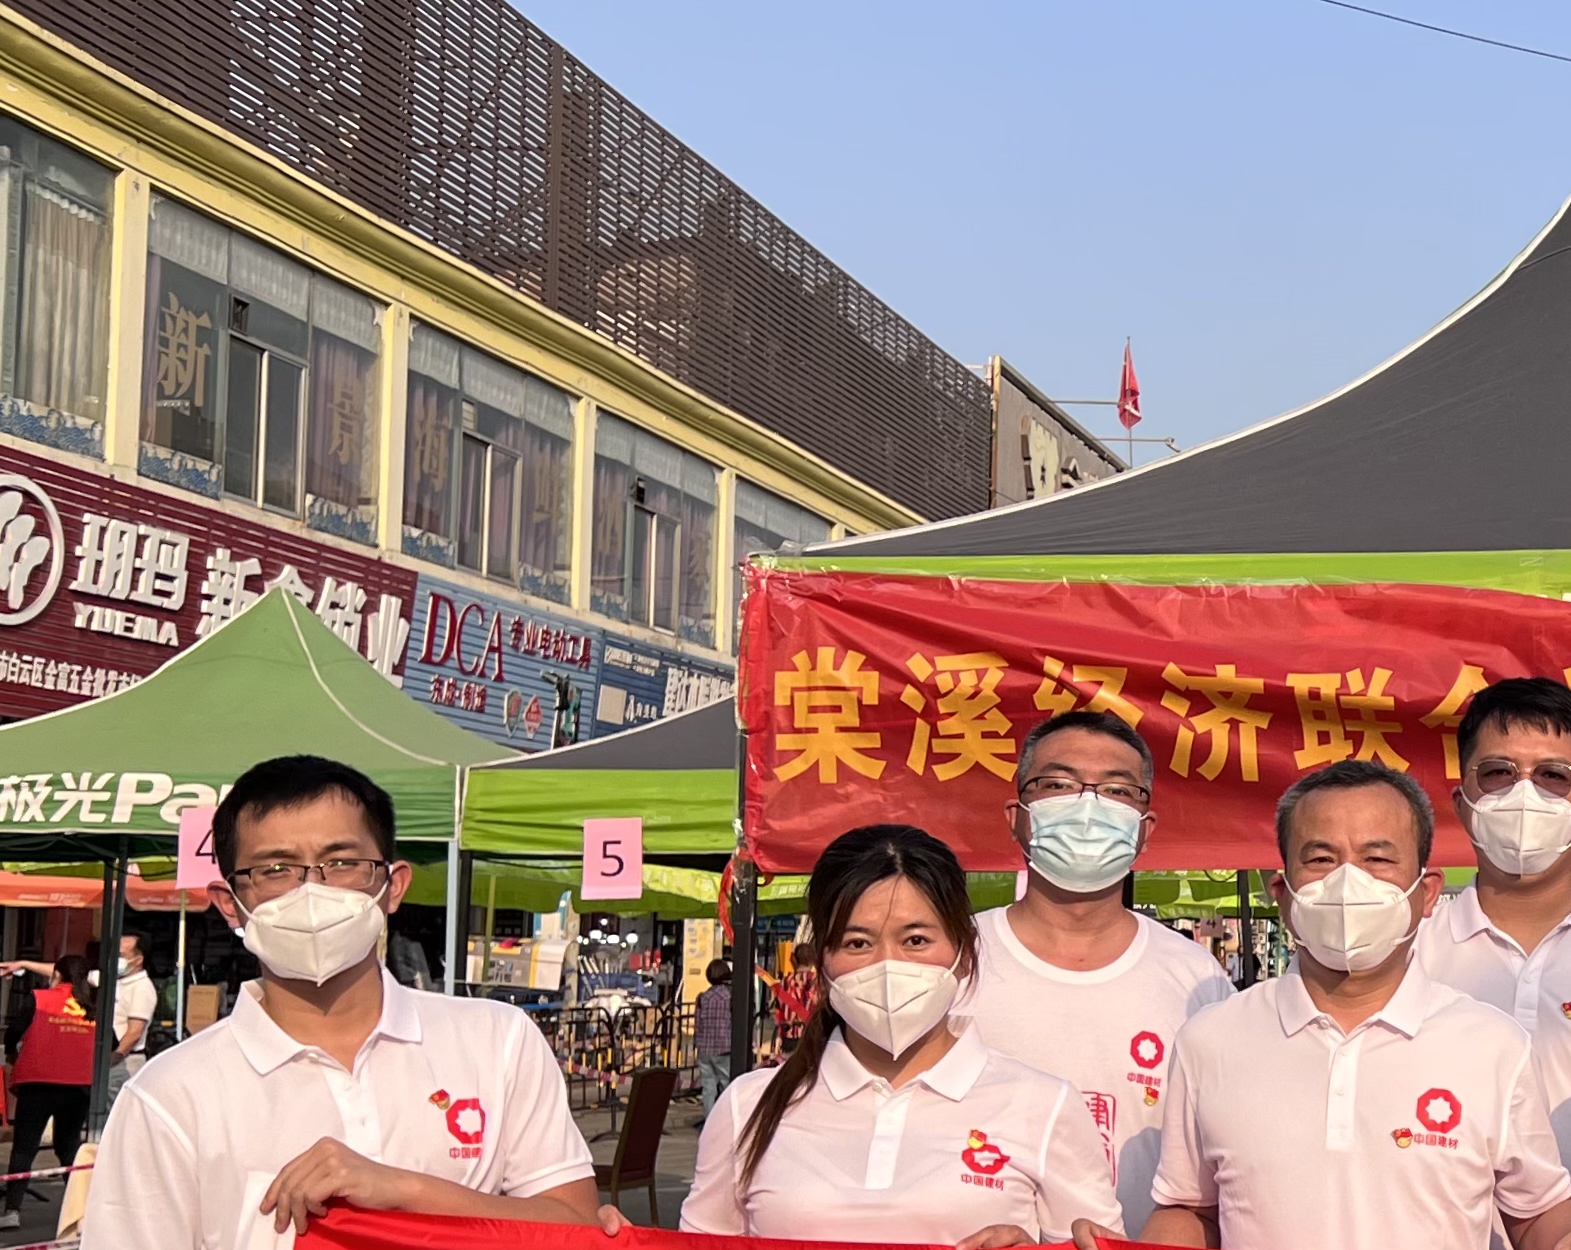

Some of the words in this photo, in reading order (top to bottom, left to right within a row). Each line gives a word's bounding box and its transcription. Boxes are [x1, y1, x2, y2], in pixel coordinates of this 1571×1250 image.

[157, 291, 213, 407] 新
[72, 602, 179, 648] YUEMA
[418, 591, 505, 683] DCA
[0, 771, 229, 824] 极光Pa
[600, 840, 624, 877] 5
[1413, 1133, 1459, 1150] 中国建材
